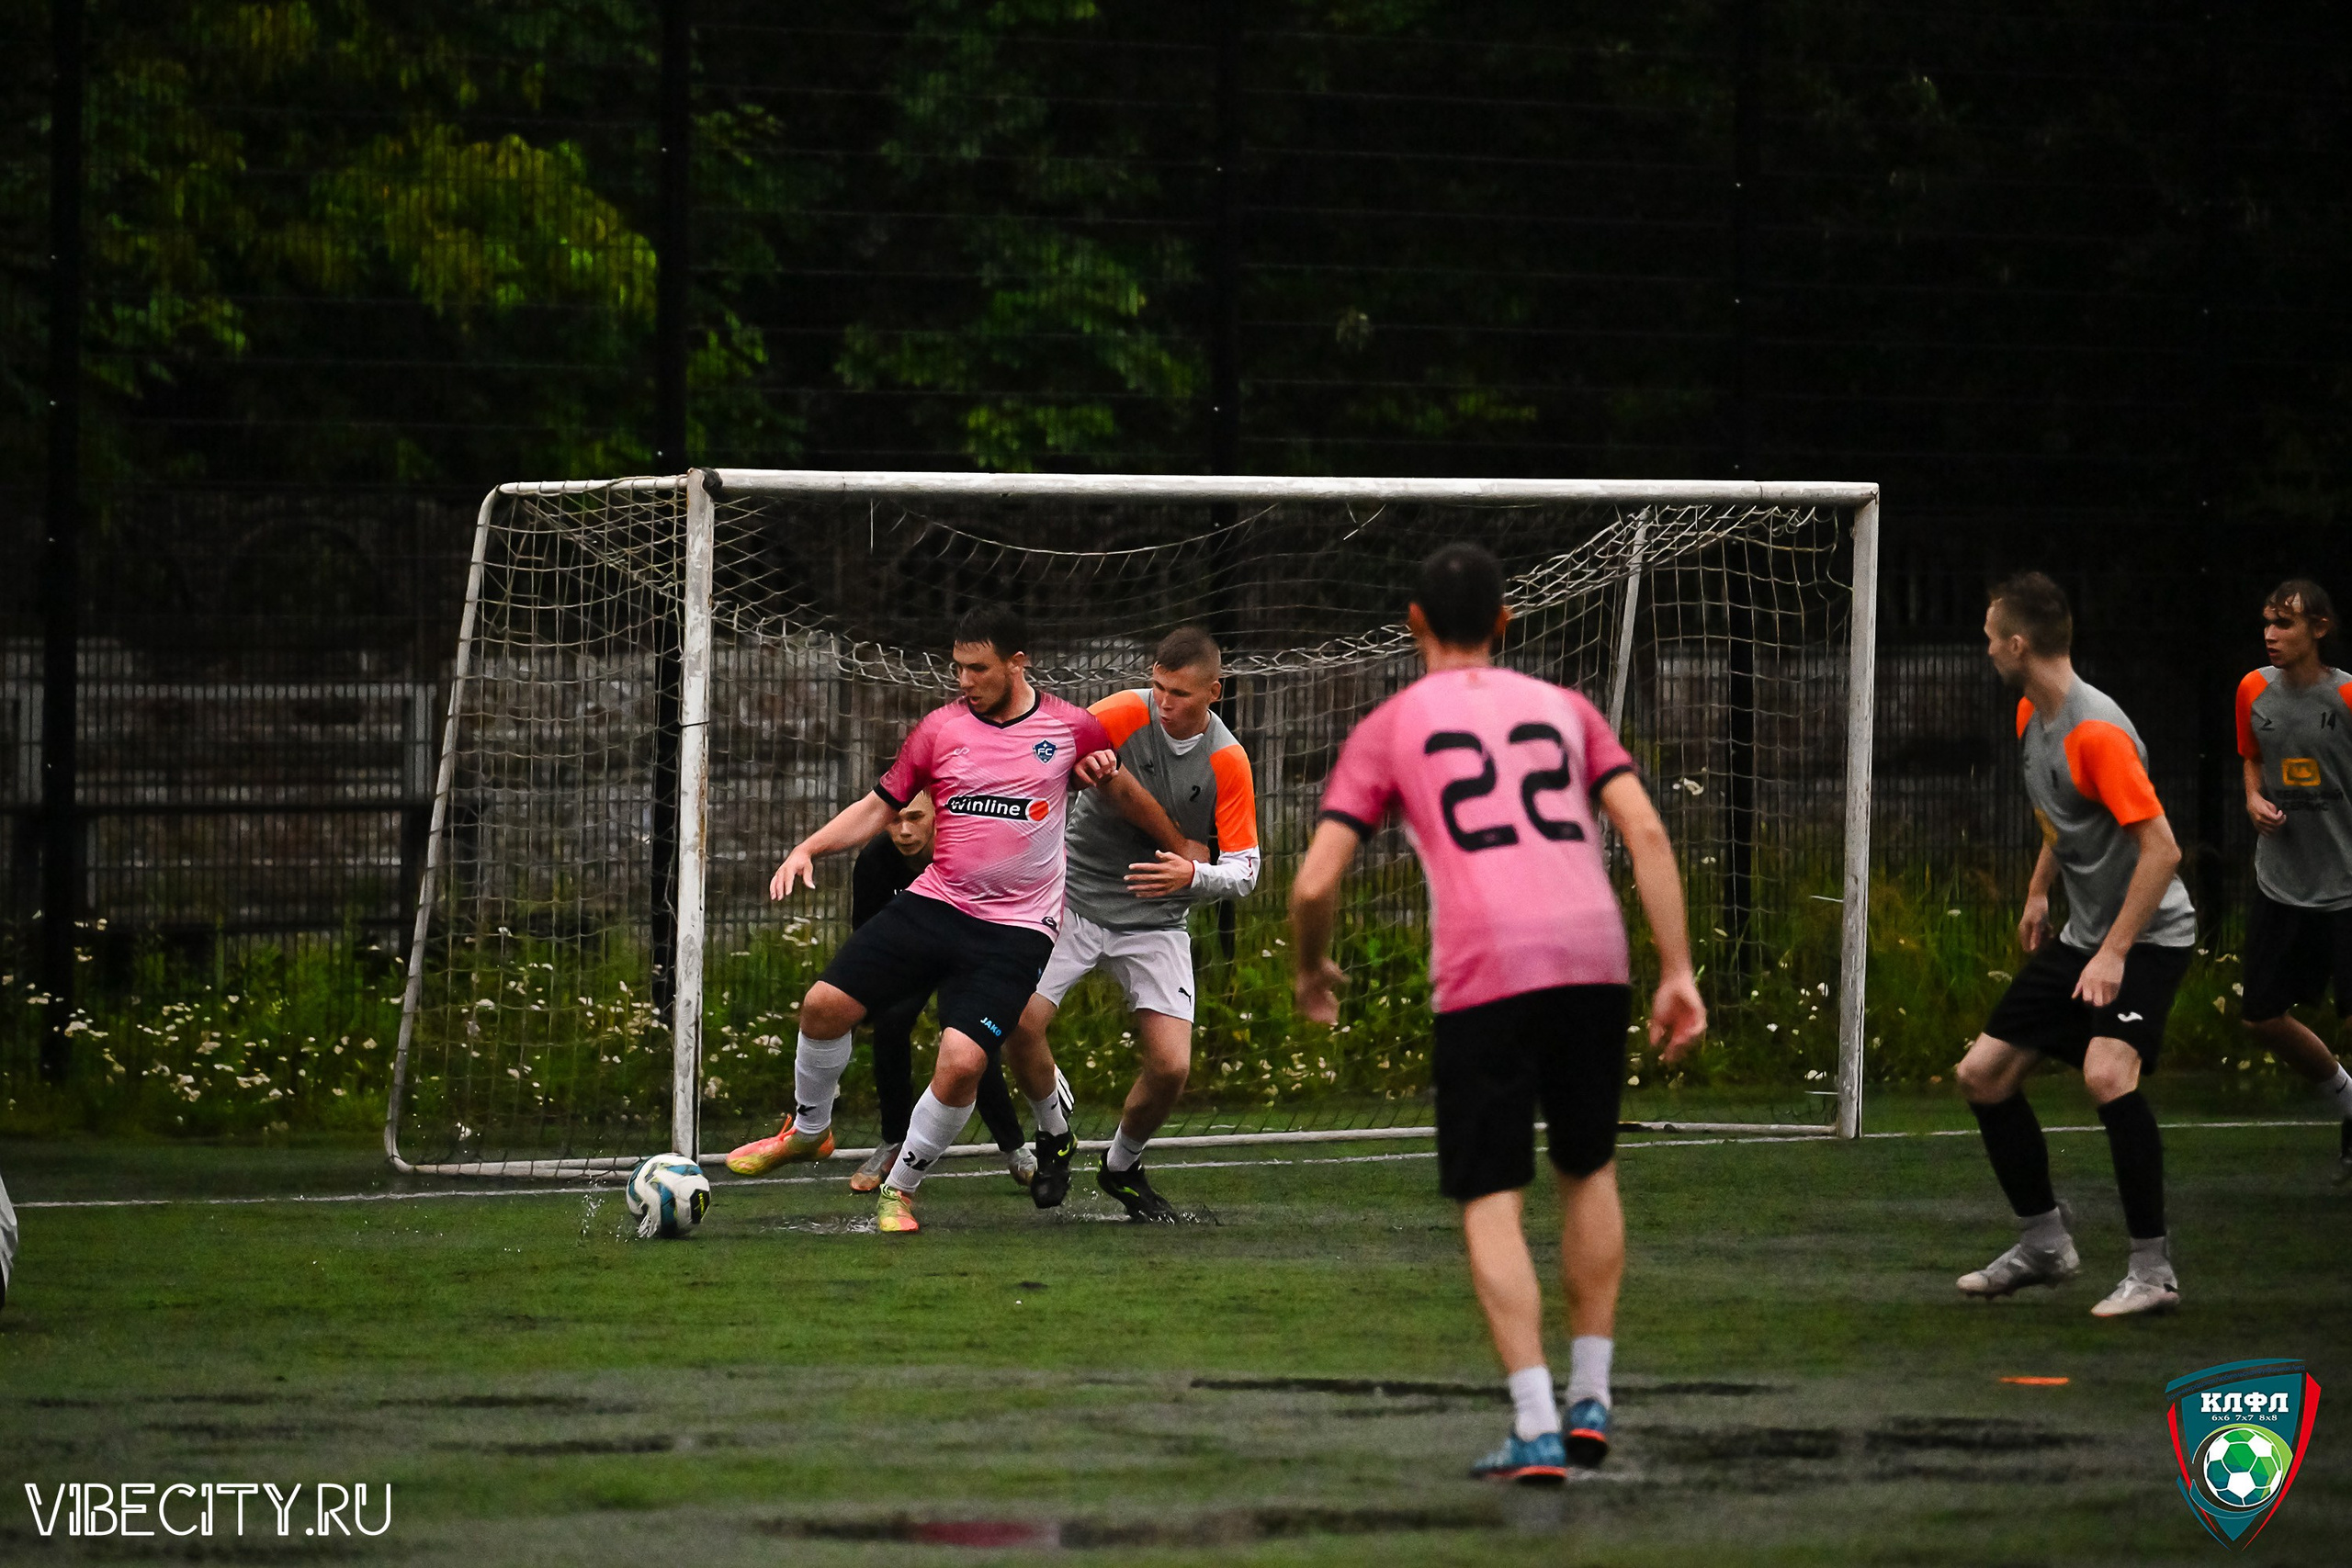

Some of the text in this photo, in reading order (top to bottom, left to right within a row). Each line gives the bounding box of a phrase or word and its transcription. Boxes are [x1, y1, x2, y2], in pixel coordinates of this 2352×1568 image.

[2320, 711, 2336, 731] 14
[1037, 748, 1053, 756] FC
[1423, 722, 1586, 852] 22
[951, 798, 1021, 817] winline
[979, 1017, 1002, 1037] JAKO
